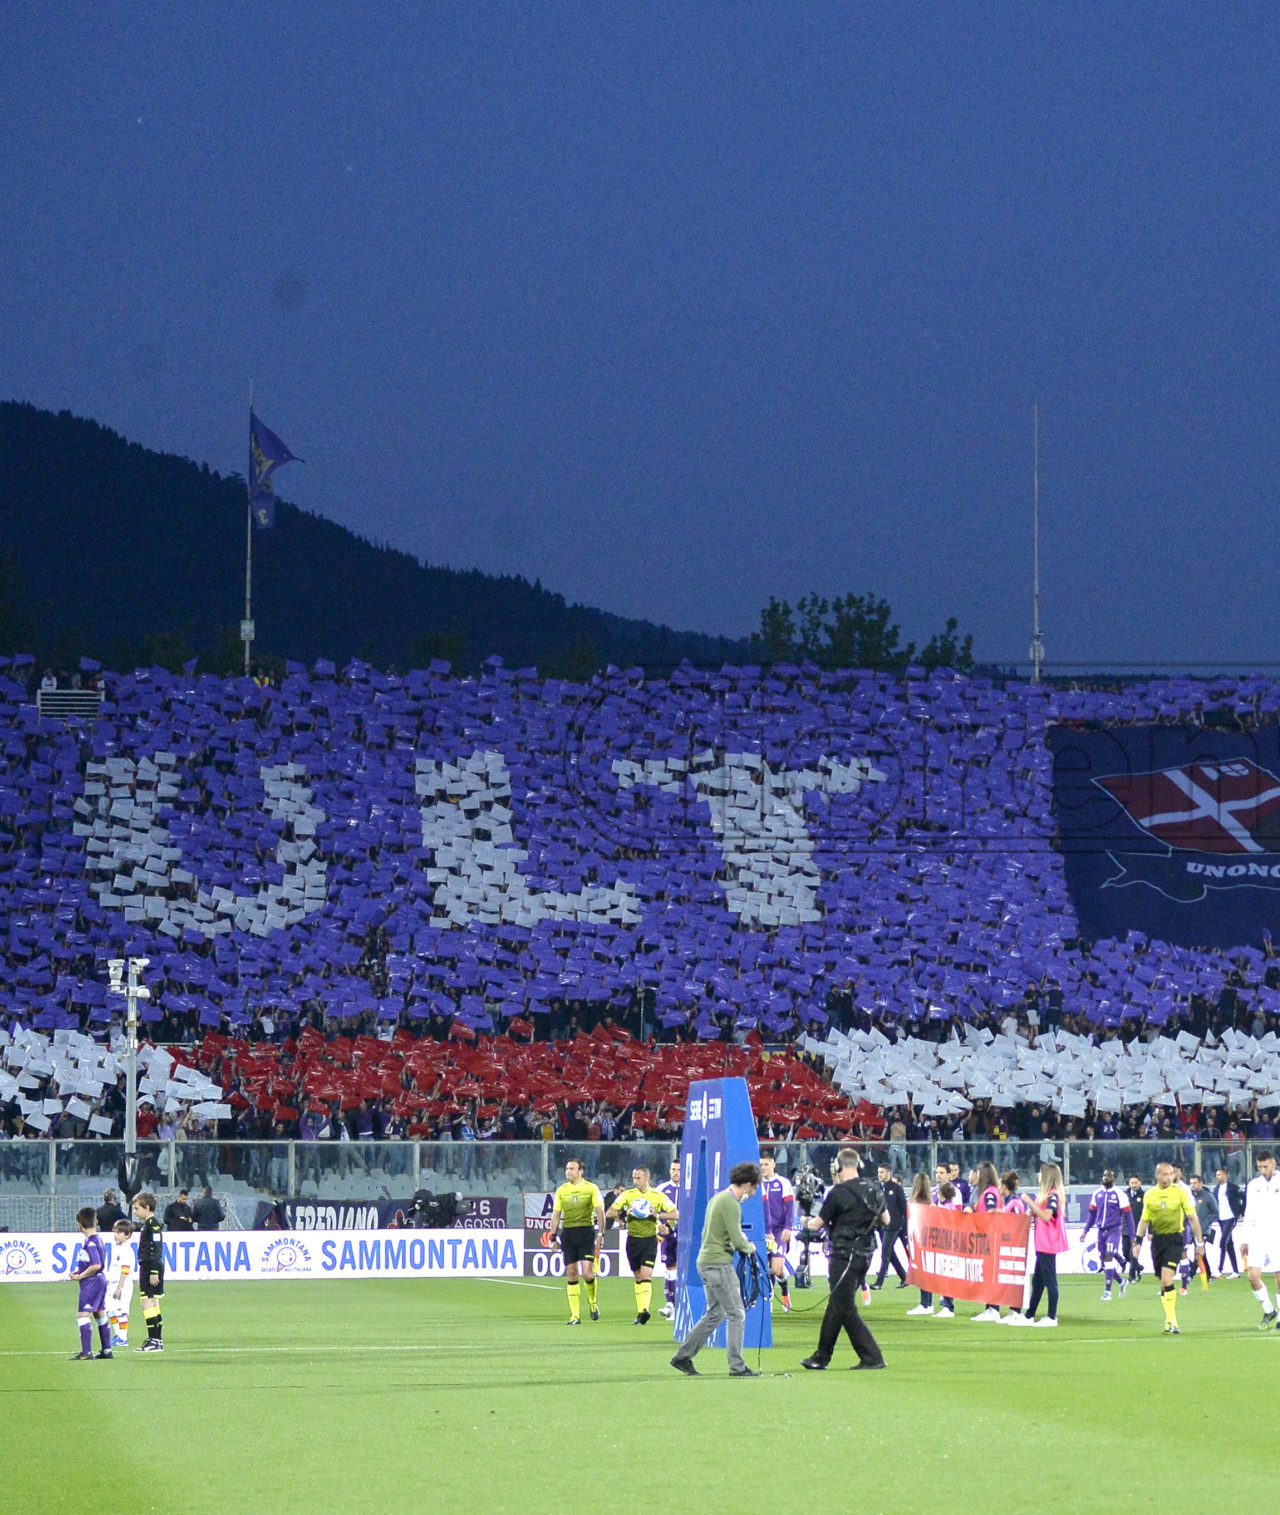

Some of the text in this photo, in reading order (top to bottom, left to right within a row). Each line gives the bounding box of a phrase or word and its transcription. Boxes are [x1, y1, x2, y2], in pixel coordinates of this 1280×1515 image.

[454, 1218, 506, 1229] AGOSTO
[261, 1237, 312, 1263] SAMMONTANA
[321, 1239, 518, 1271] SAMMONTANA
